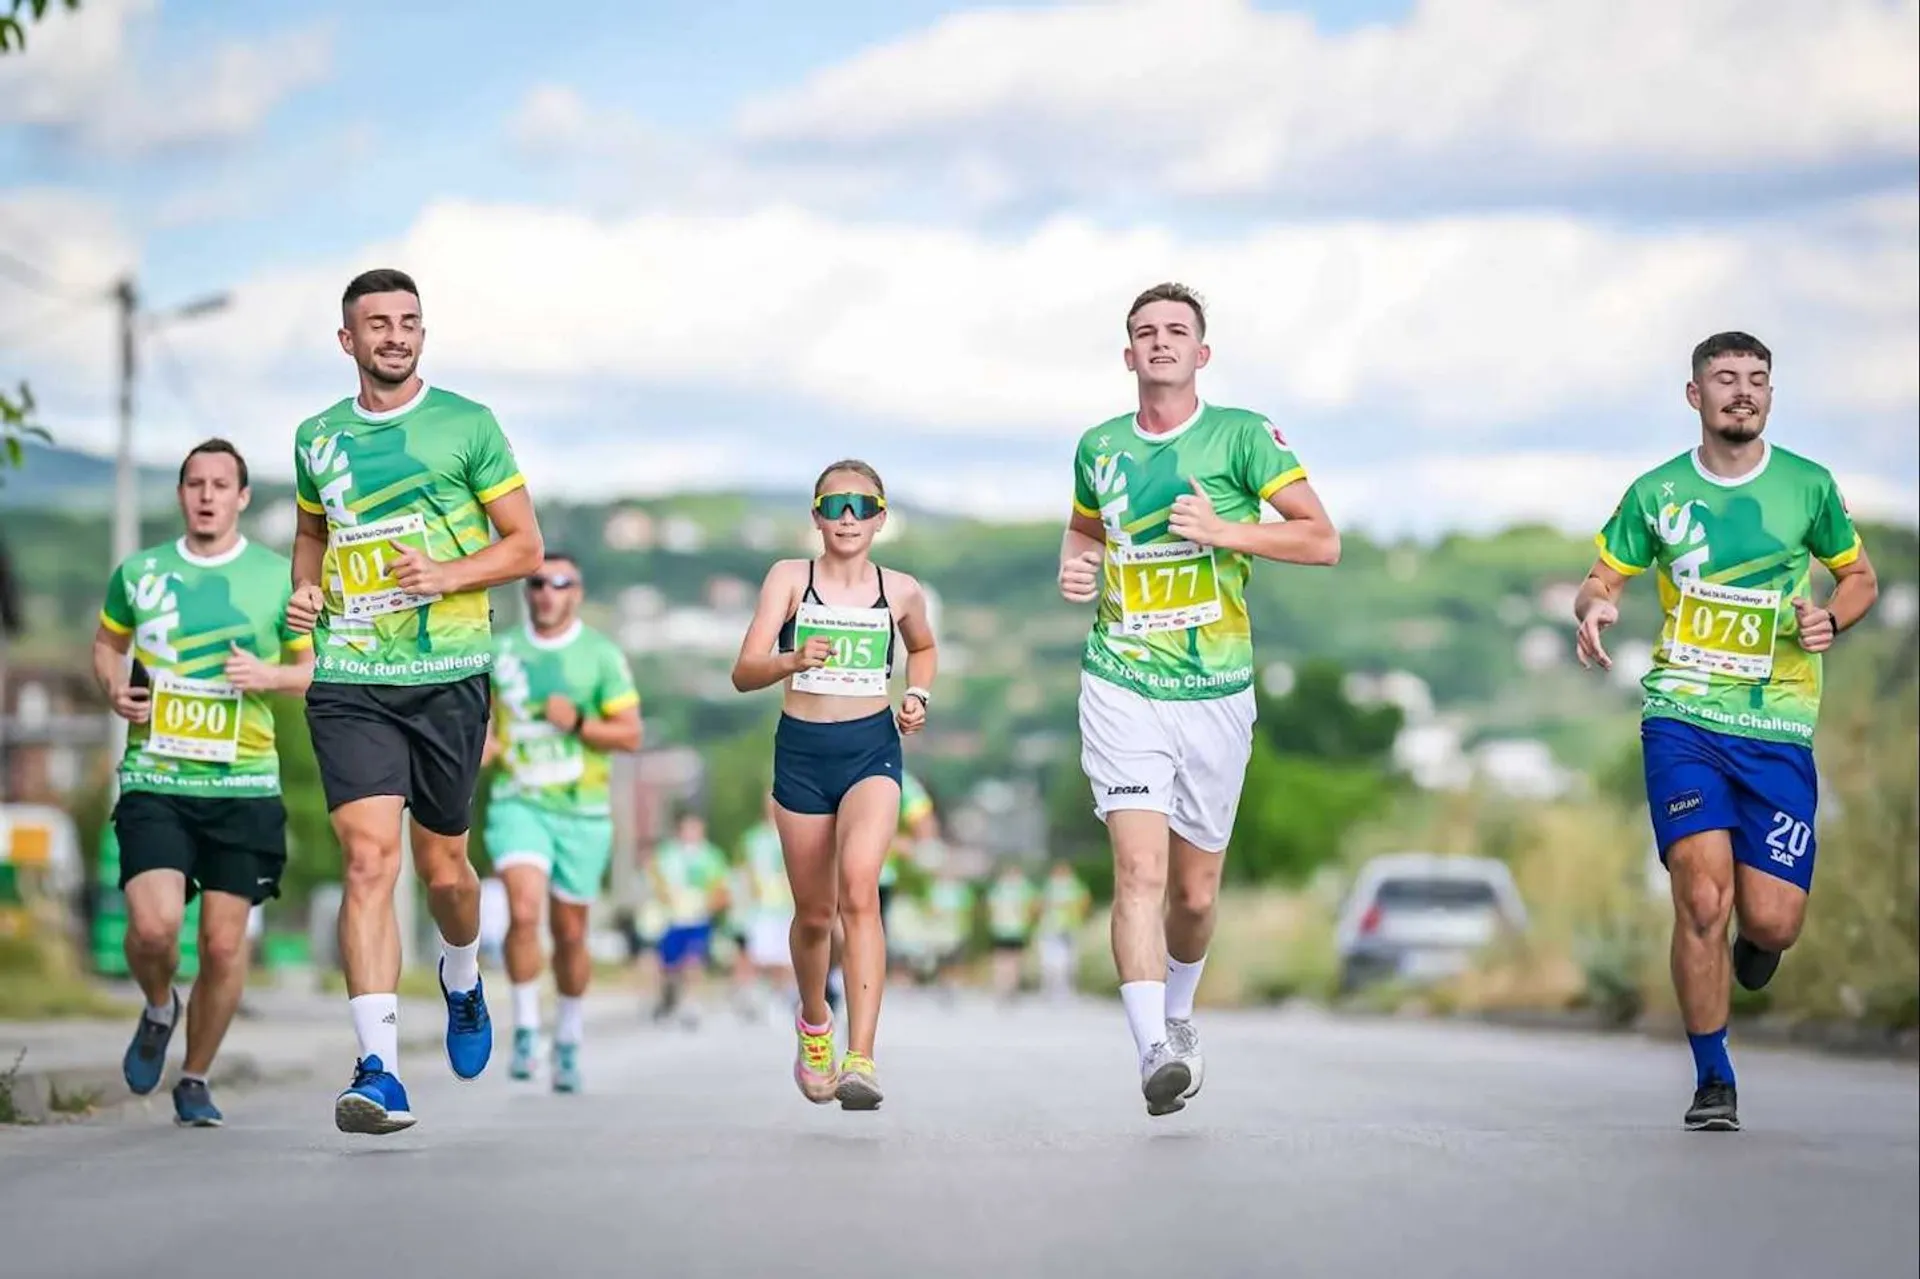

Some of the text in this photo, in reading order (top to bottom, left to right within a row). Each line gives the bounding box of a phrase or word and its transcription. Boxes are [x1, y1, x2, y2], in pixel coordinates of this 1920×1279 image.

[349, 547, 396, 586] 01
[1136, 563, 1199, 604] 177
[1692, 606, 1762, 648] 078
[322, 655, 334, 670] &
[339, 659, 370, 676] 10K
[374, 662, 407, 676] Run
[410, 652, 491, 674] Challenge
[825, 636, 873, 668] 05
[1148, 674, 1180, 689] Run
[165, 697, 227, 735] 090
[1702, 709, 1734, 724] Run
[1107, 785, 1150, 796] LEGEA
[1765, 811, 1812, 857] 20
